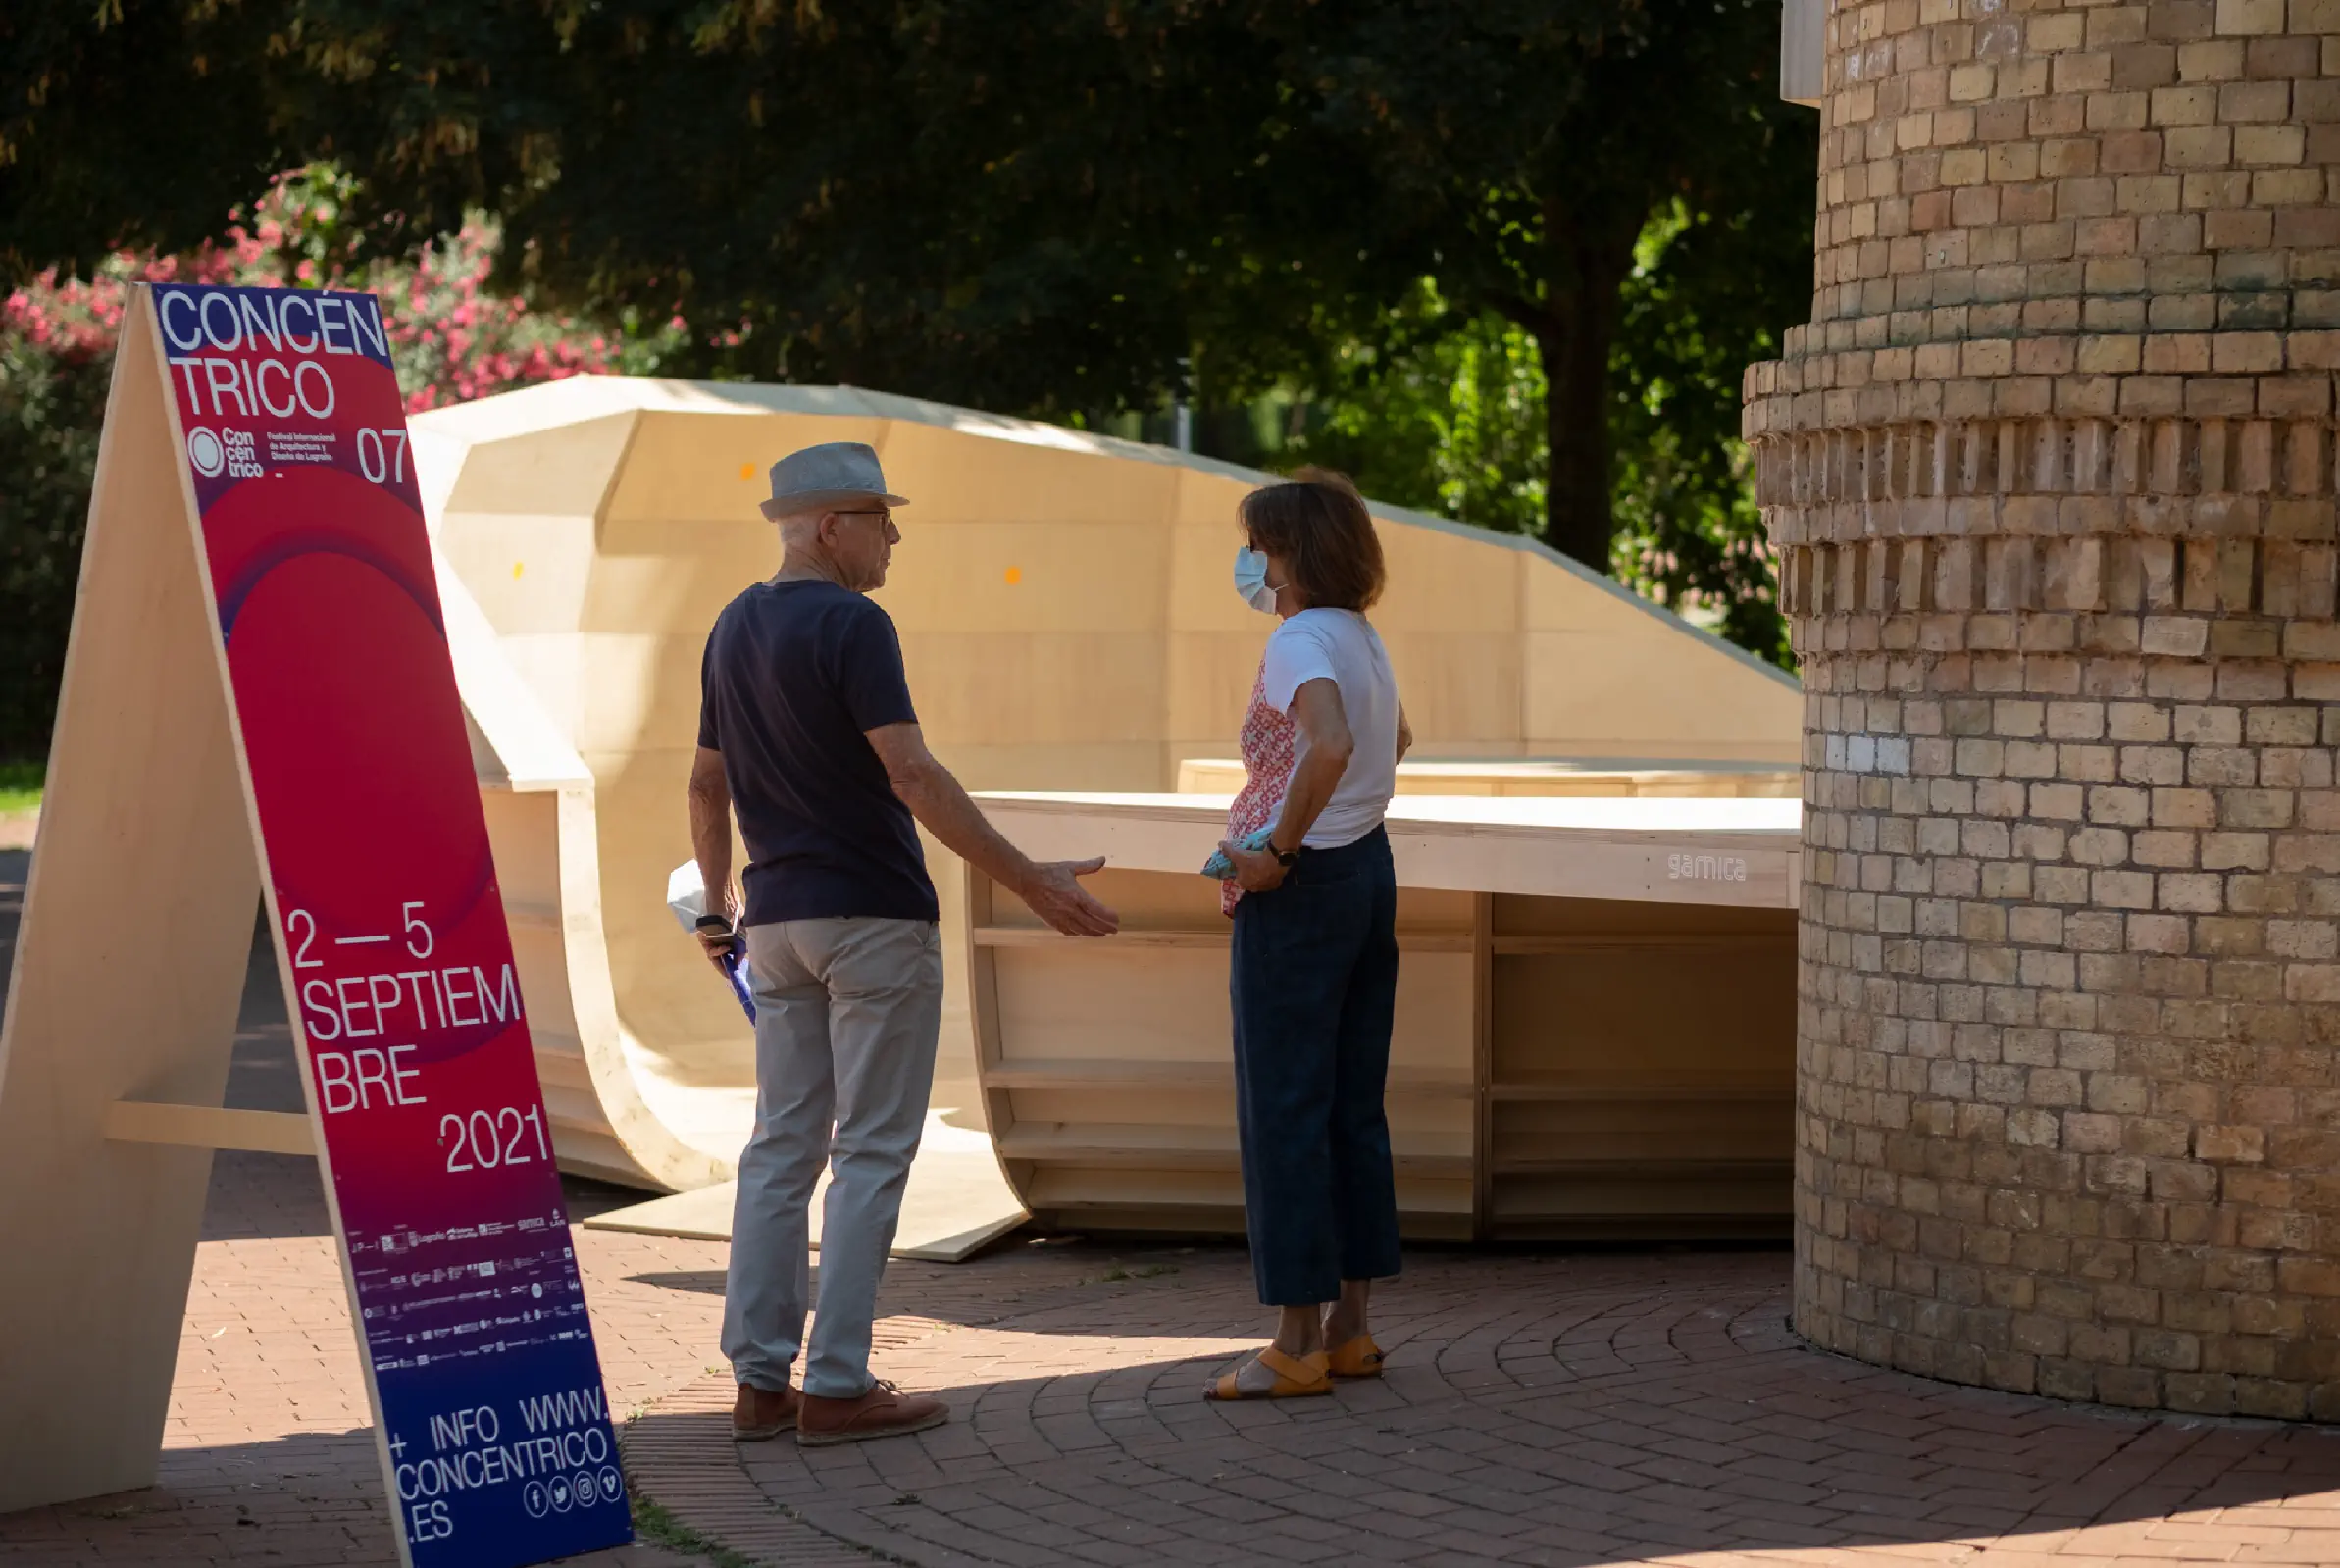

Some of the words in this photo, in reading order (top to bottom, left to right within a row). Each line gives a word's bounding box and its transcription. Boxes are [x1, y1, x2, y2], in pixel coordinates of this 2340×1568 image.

[161, 289, 388, 356] CONCÉN
[169, 357, 335, 420] TRICO
[222, 427, 254, 445] Con
[228, 459, 264, 478] trico
[357, 428, 407, 483] 07
[1668, 854, 1746, 881] garnica
[288, 909, 324, 968] 2
[403, 901, 434, 959] 5
[304, 964, 521, 1040] SEPTIEM
[317, 1044, 427, 1114] BRE
[440, 1104, 548, 1172] 2021
[430, 1405, 500, 1451] INFO
[396, 1427, 608, 1500] CONCENTRICO
